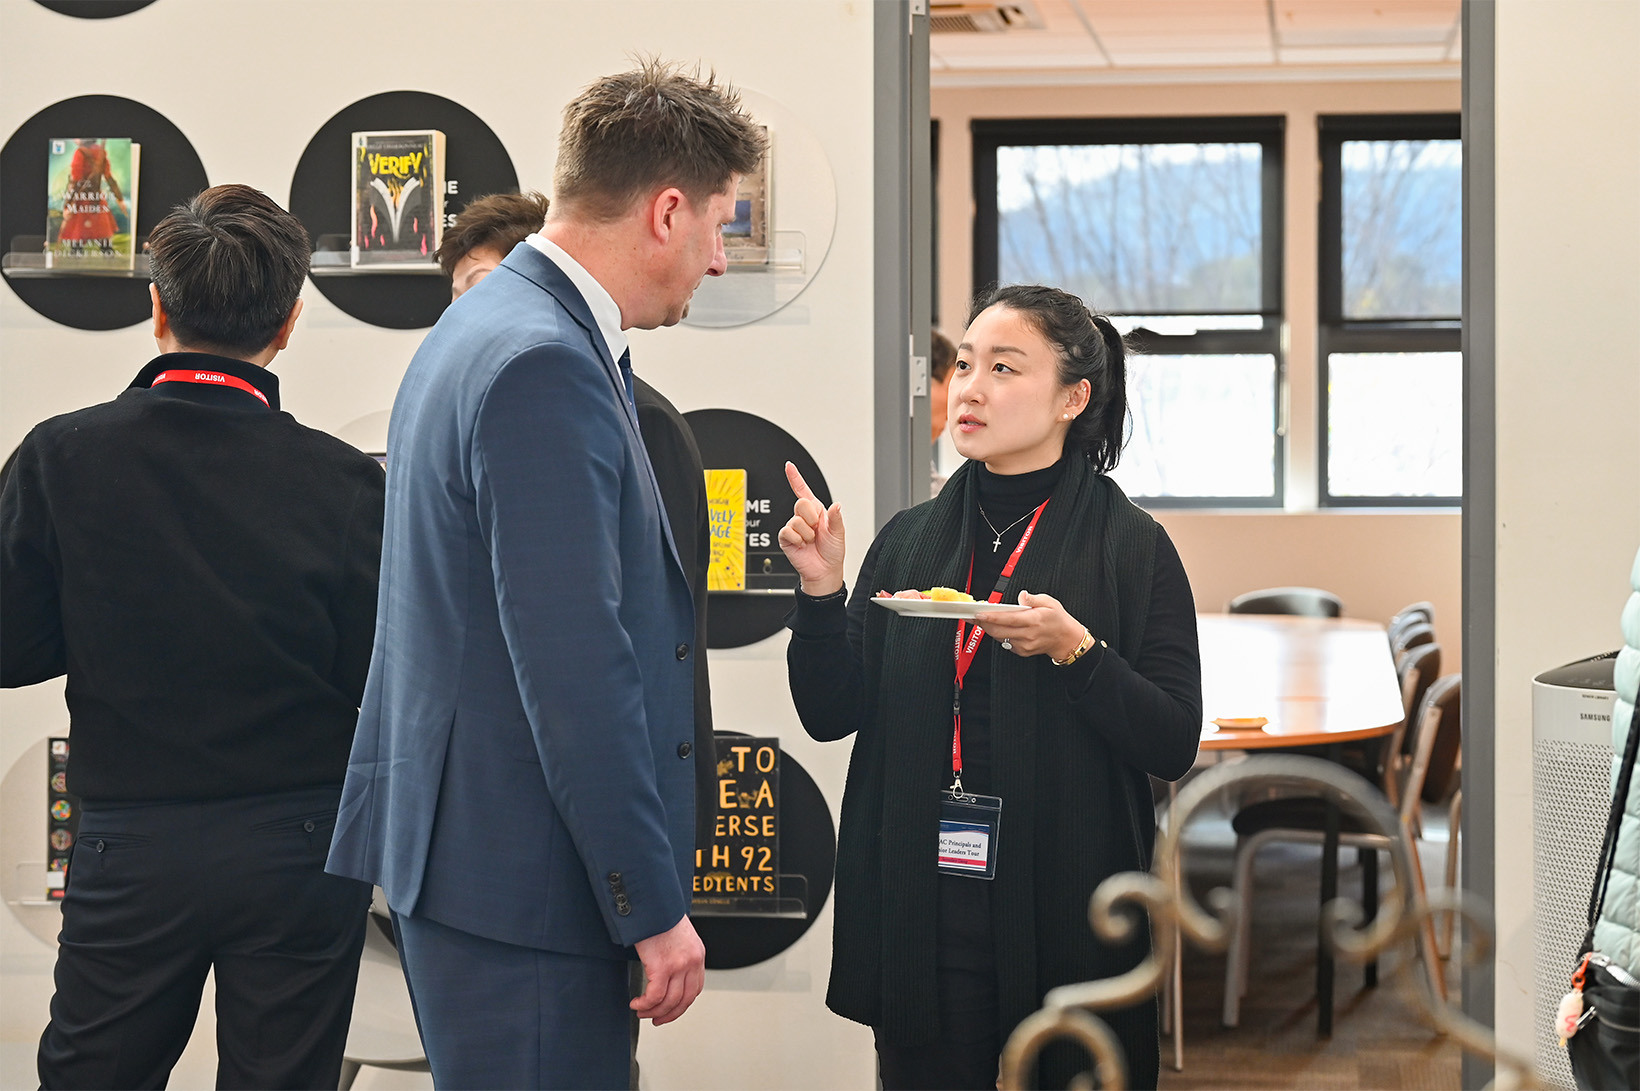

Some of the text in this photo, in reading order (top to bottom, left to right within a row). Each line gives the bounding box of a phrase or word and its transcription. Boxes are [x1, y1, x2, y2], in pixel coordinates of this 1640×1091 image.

[368, 152, 423, 179] VERIFY
[62, 190, 117, 201] WARRIOR
[443, 180, 459, 195] E
[66, 203, 111, 214] MAIDEN
[194, 373, 226, 383] VISITOR
[710, 508, 737, 525] VELY
[710, 524, 732, 539] AGE
[1015, 526, 1033, 554] VISITOR
[1580, 713, 1611, 722] SAMSUNG
[730, 746, 775, 773] TO
[719, 779, 774, 809] E A
[715, 815, 775, 837] ERSE
[948, 840, 972, 849] Principals
[948, 847, 967, 856] Leaders
[741, 846, 773, 871] 92
[693, 875, 775, 892] EDIENTS
